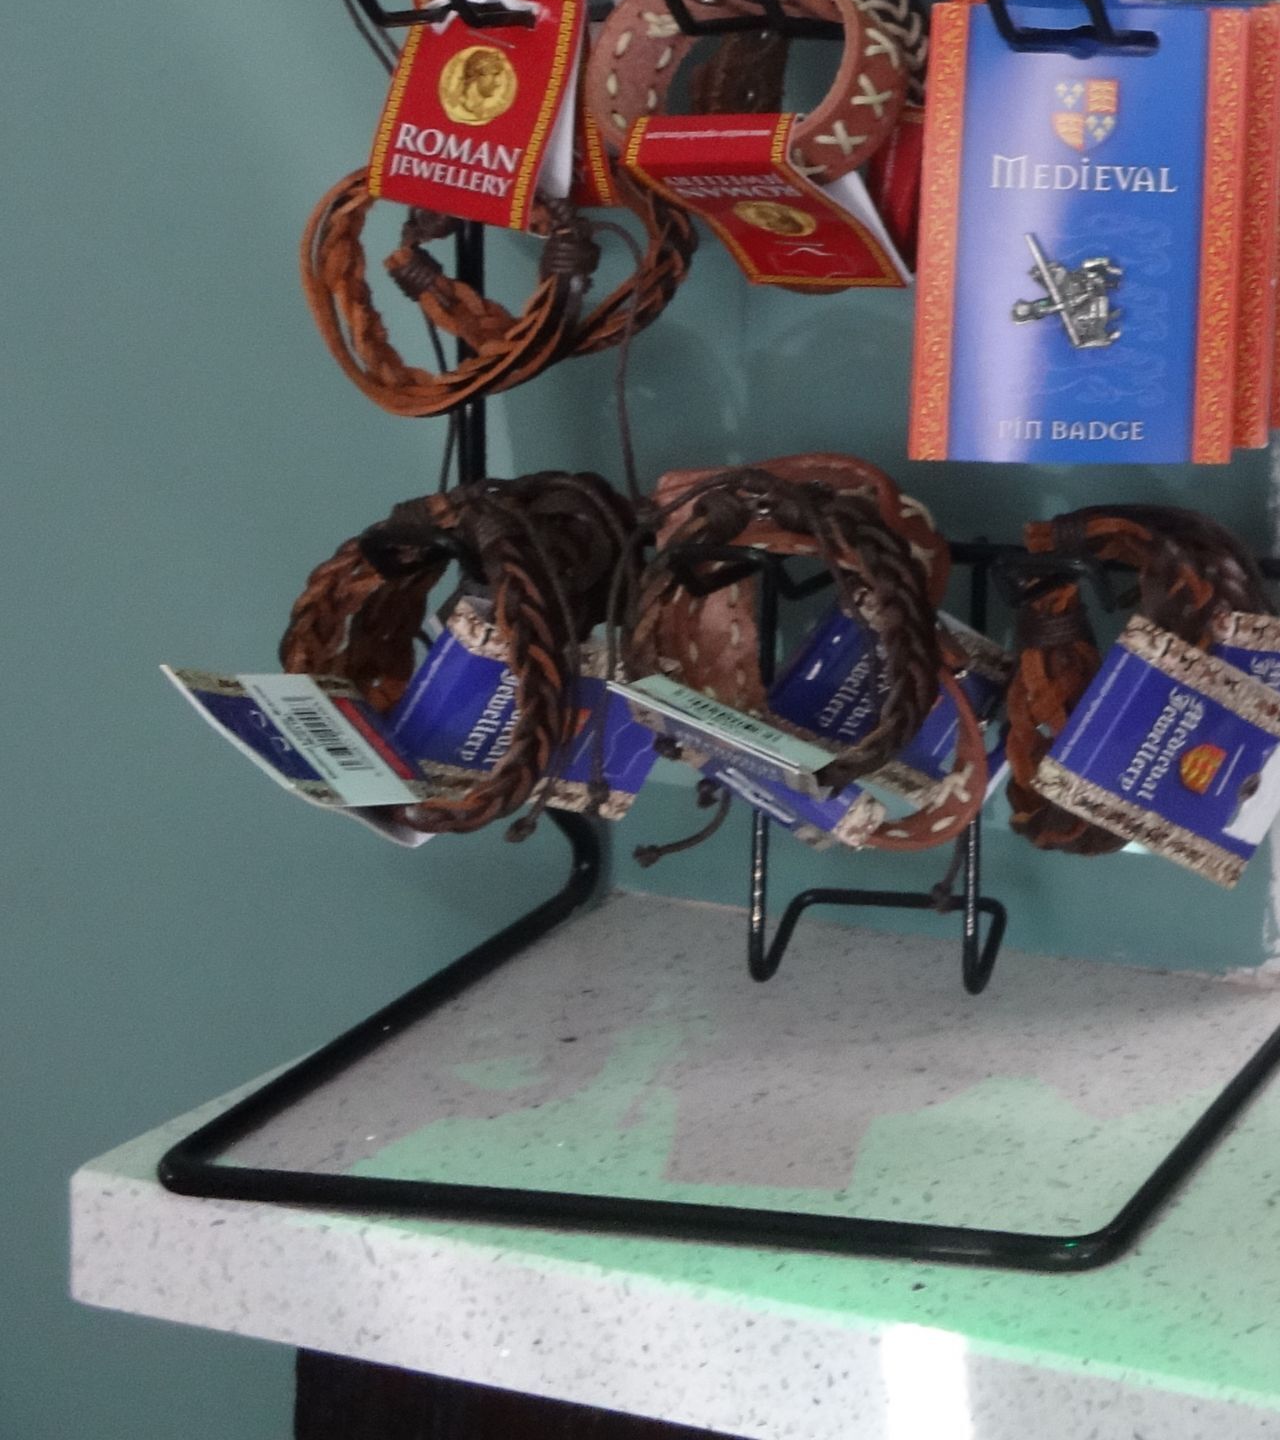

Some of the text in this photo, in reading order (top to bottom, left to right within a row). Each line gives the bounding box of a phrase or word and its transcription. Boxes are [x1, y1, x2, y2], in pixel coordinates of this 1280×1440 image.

[395, 121, 523, 172] ROMAN
[390, 154, 515, 198] JEWELLERY
[1050, 420, 1146, 442] BADGE
